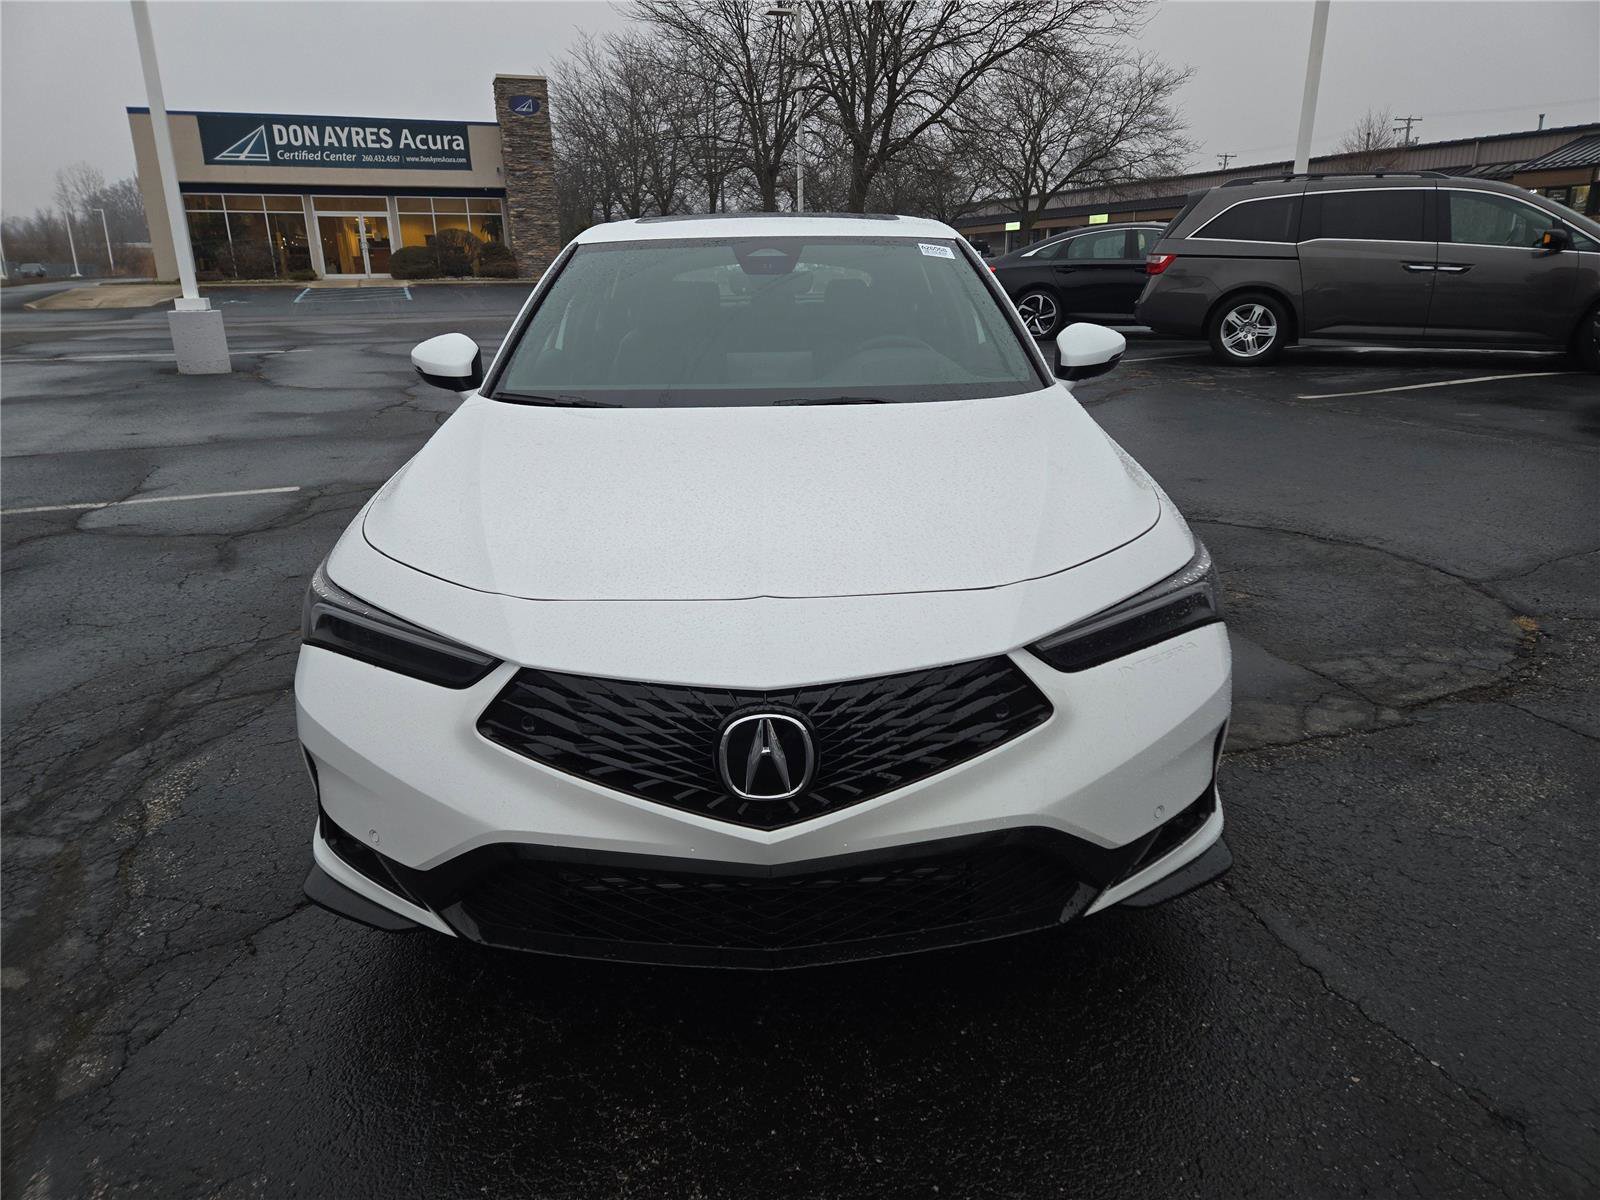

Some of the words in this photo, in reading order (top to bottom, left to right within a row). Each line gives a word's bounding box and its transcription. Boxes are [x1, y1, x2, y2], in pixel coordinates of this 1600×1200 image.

[272, 124, 319, 146] DON
[323, 126, 393, 149] AYRES
[399, 129, 465, 150] Acura
[277, 150, 322, 161] Certified
[323, 151, 356, 162] Center
[362, 154, 400, 163] 260.432.4567
